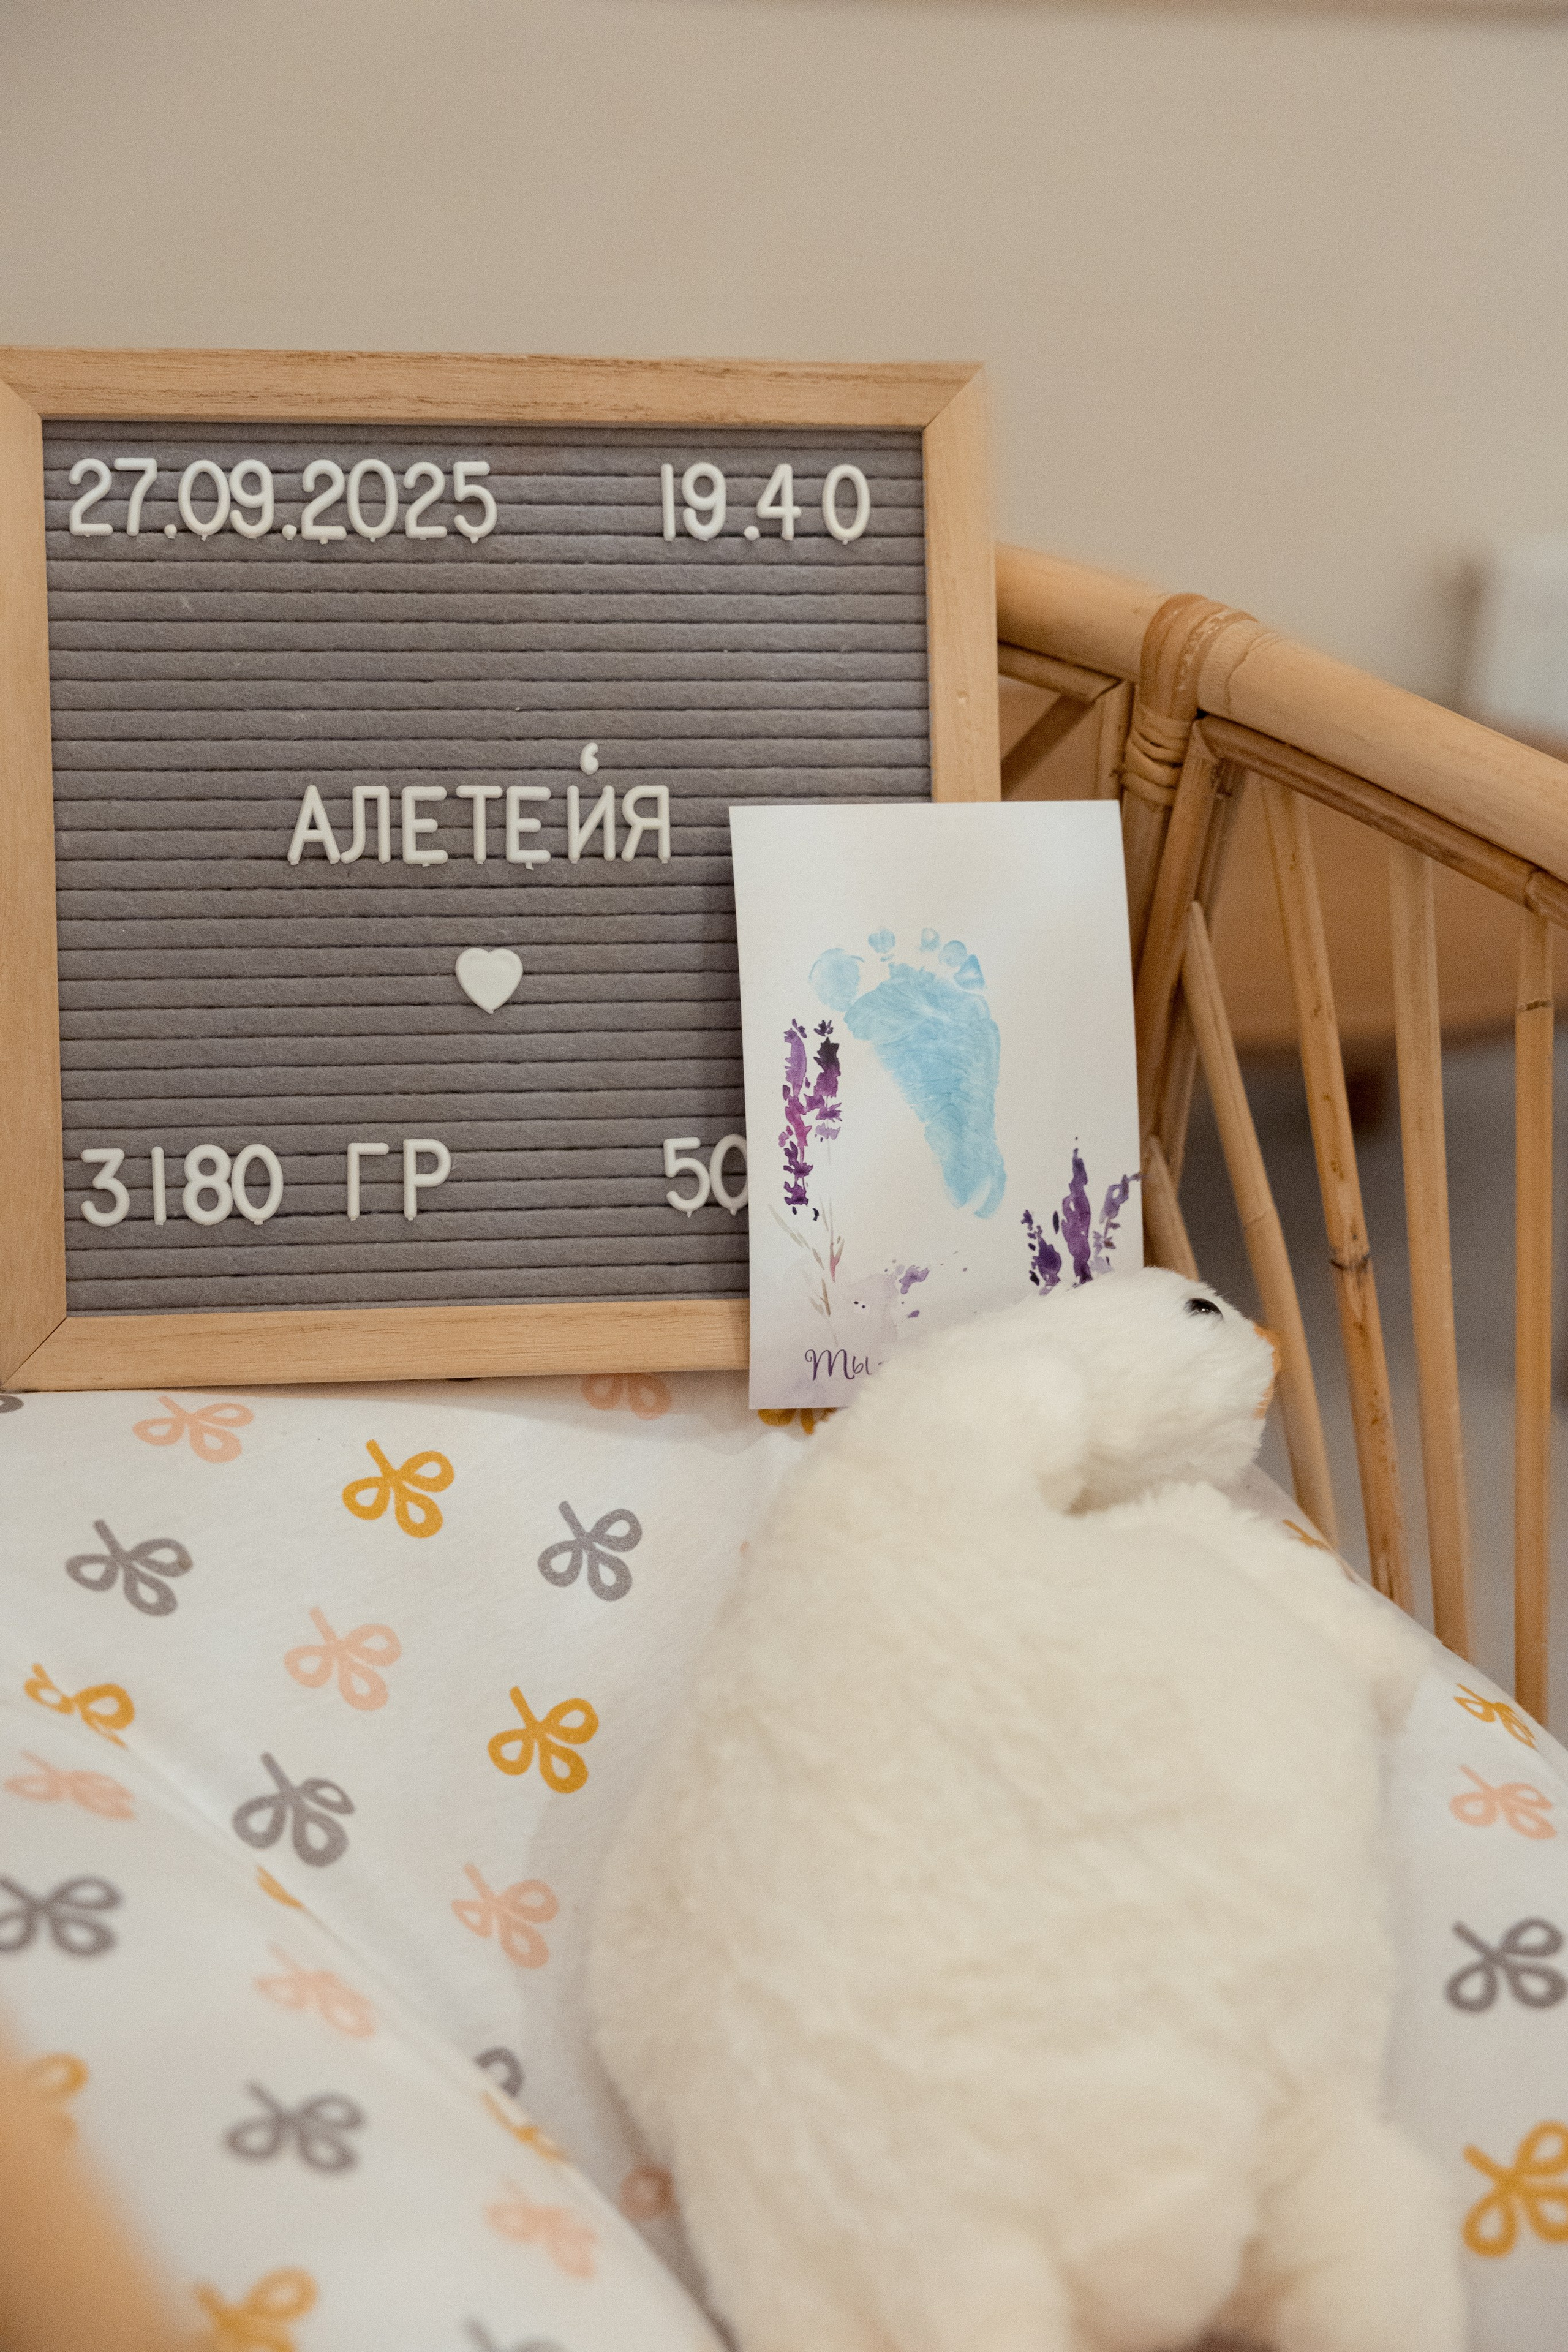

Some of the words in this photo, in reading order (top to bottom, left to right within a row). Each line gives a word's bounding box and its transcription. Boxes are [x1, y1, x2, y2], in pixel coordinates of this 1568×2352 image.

[69, 458, 497, 543] 27.09.2025
[661, 462, 870, 544] 19.40
[81, 1144, 284, 1226] 3180
[347, 1139, 451, 1221] ГР
[663, 1133, 748, 1217] 50
